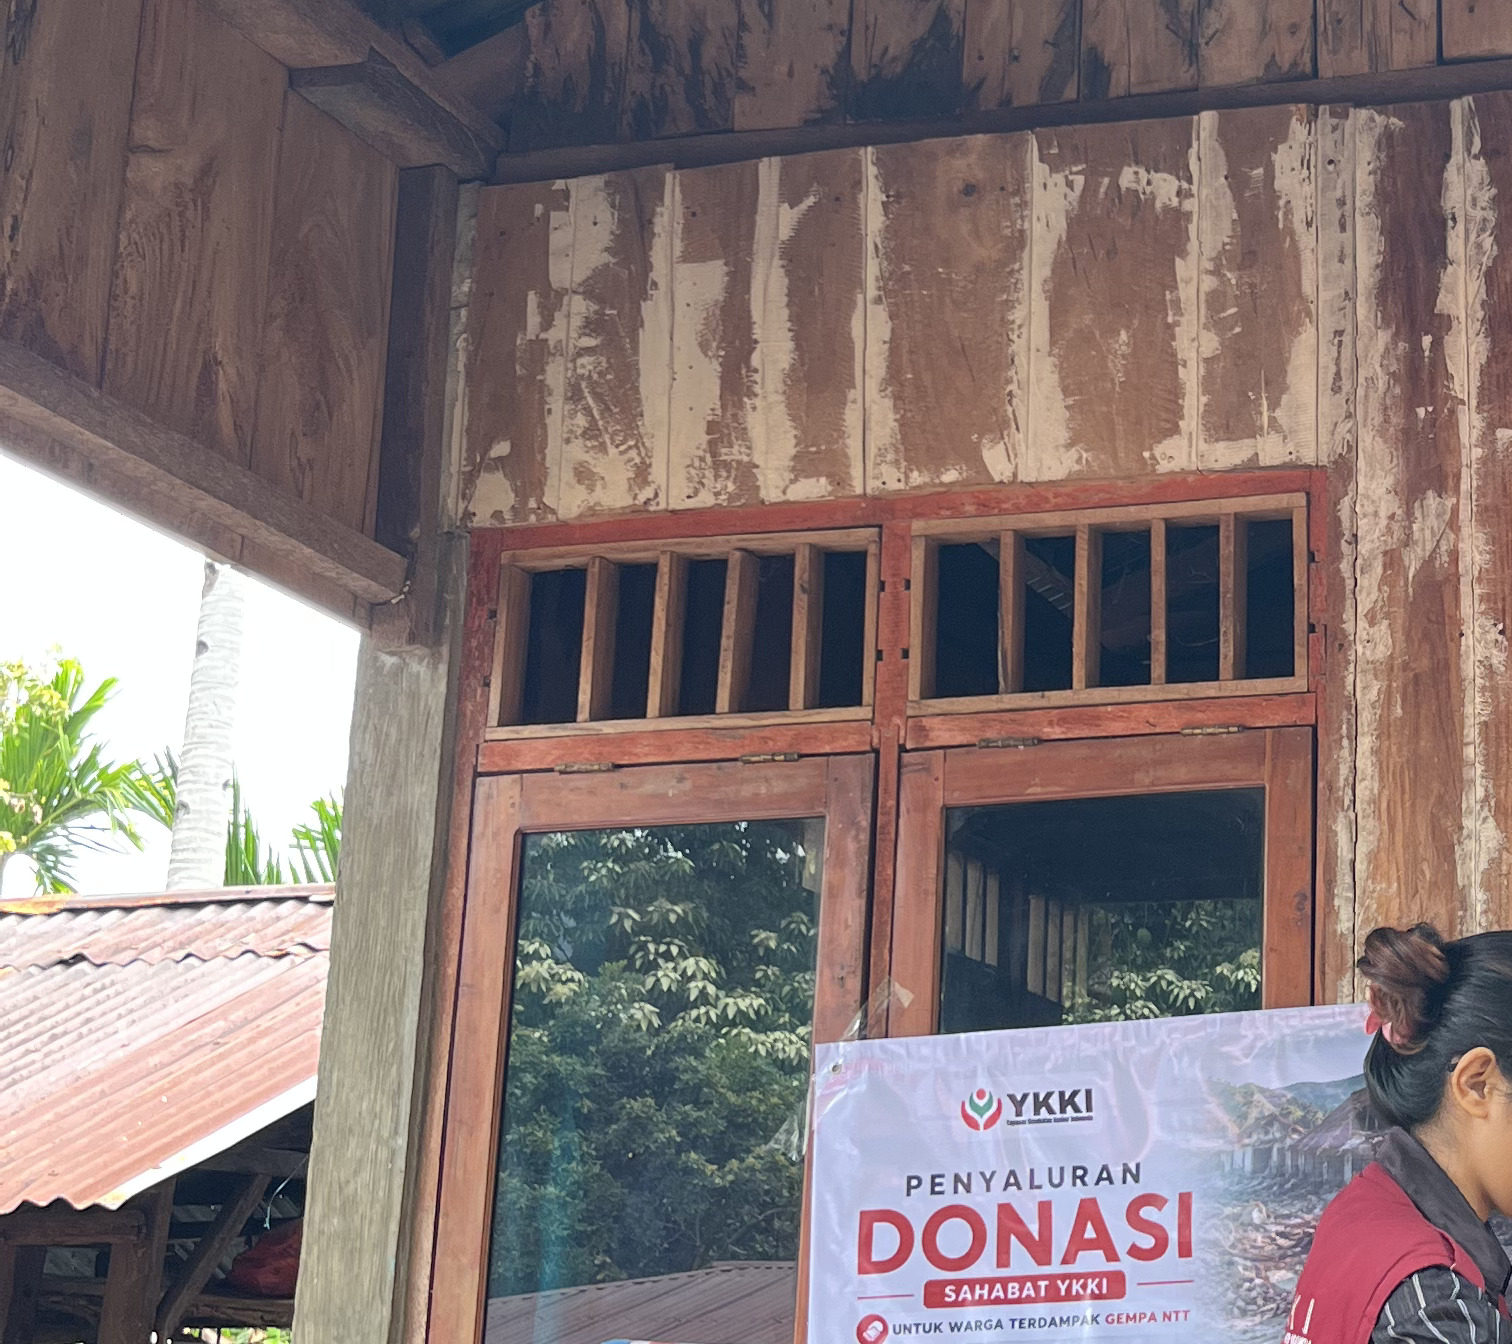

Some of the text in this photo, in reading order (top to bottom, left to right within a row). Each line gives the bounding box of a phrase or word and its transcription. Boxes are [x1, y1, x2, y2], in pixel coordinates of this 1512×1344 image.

[1006, 1088, 1094, 1117] YKKI
[906, 1162, 1142, 1197] PENYALURAN
[857, 1191, 1194, 1275] DONASI
[943, 1277, 1108, 1302] SAHABAT YKKI
[892, 1309, 1191, 1335] UNTUK WARGA TERDAMPAK GEMPA NTT
